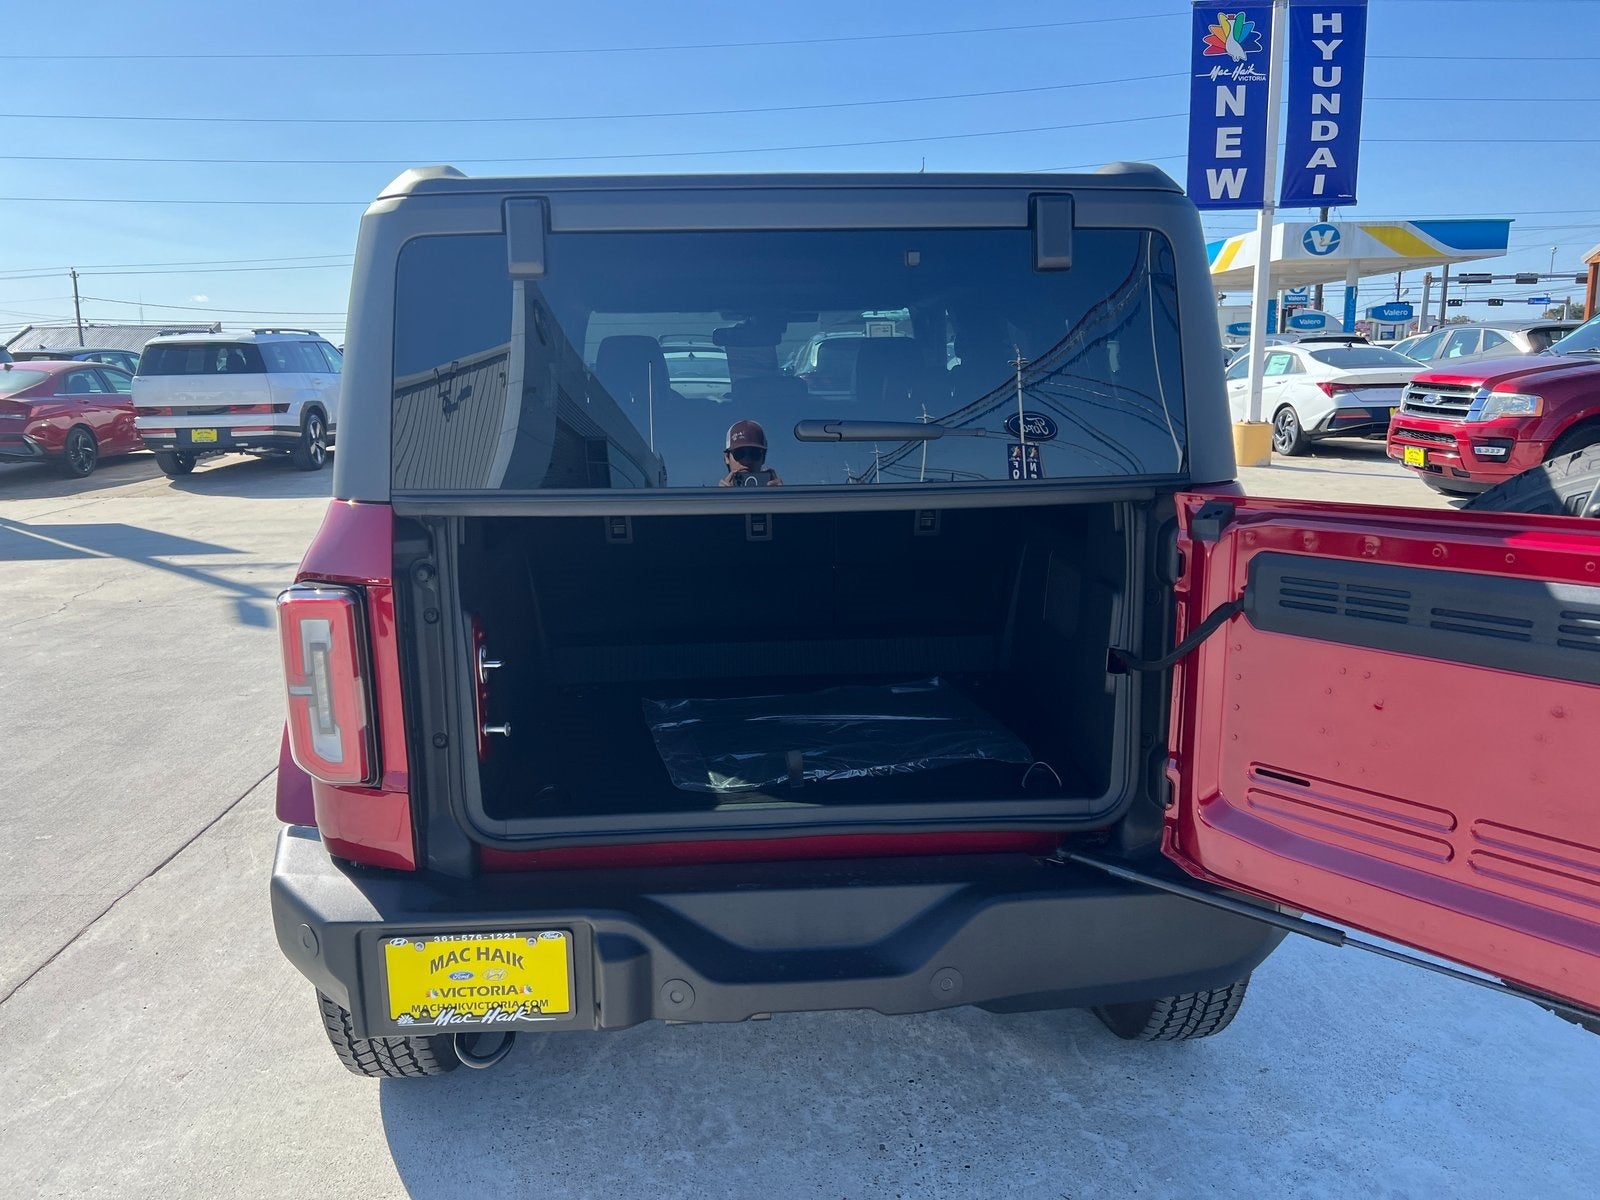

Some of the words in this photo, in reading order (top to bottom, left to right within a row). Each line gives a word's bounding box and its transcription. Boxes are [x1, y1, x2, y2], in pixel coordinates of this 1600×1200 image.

[1203, 65, 1232, 82] Mac
[1231, 62, 1262, 82] Haik
[1306, 12, 1343, 195] HYUNDAI
[1206, 84, 1247, 200] NEW
[433, 932, 517, 943] 361-576-1221
[430, 947, 471, 974] MAC
[476, 946, 525, 970] HAIK
[439, 985, 519, 998] VICTORIA
[424, 1008, 480, 1027] Mac
[481, 1006, 538, 1024] Haik
